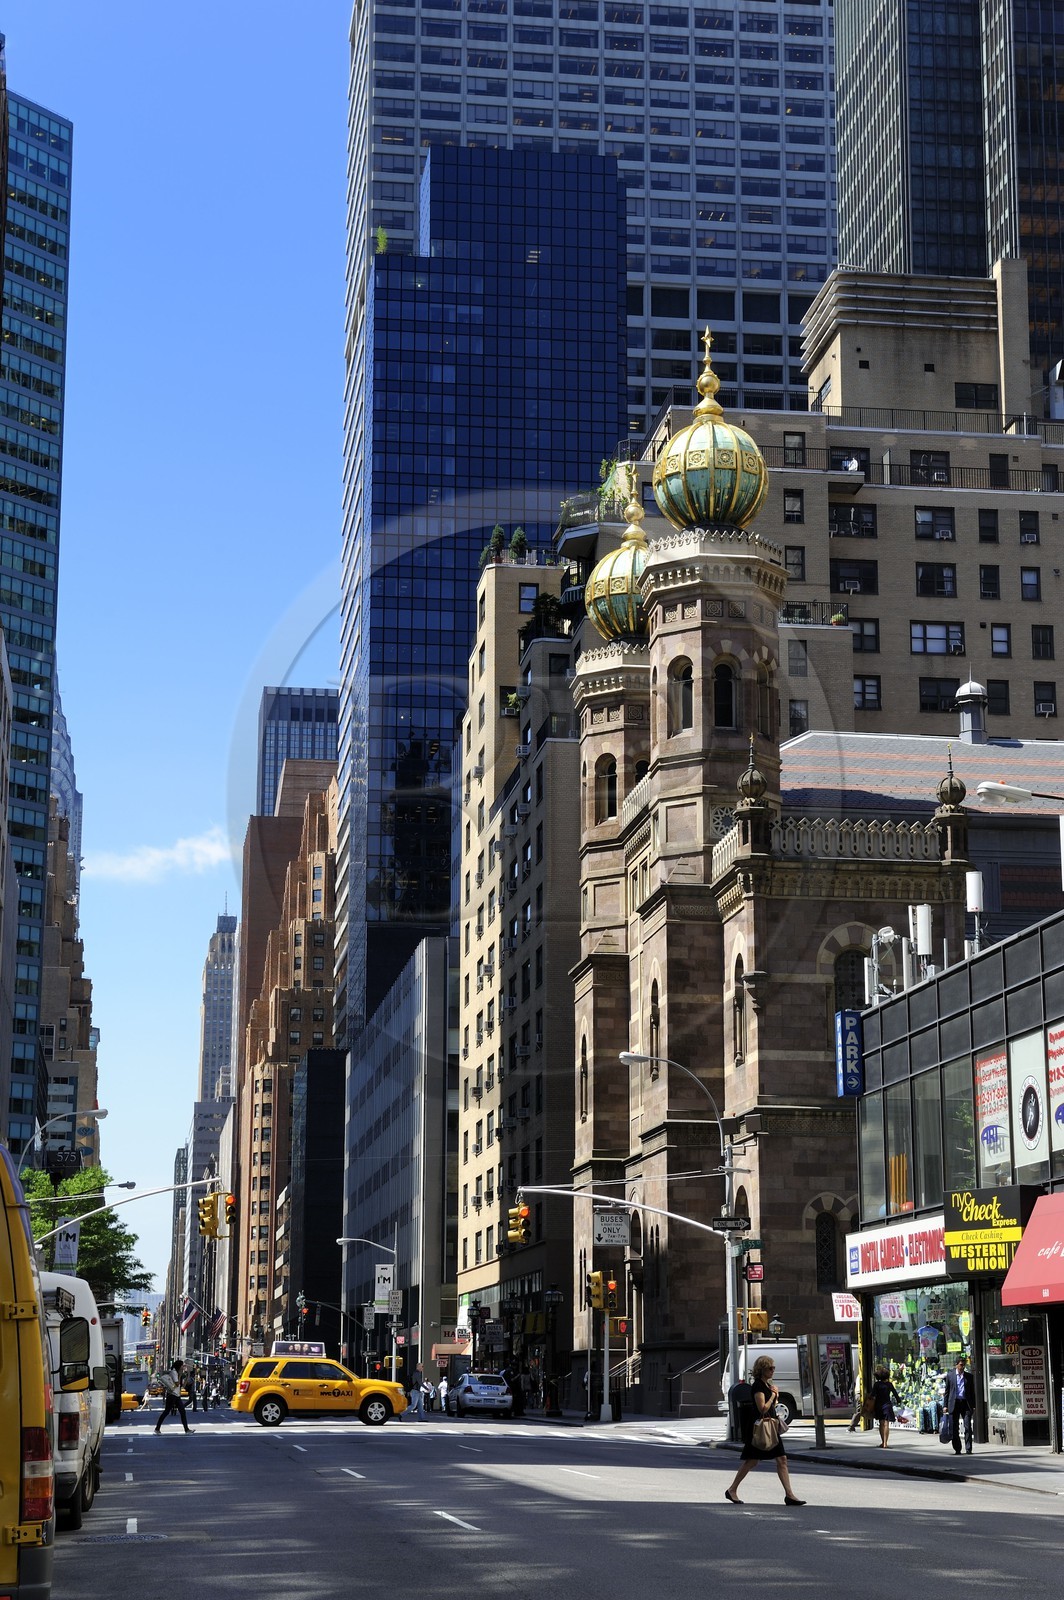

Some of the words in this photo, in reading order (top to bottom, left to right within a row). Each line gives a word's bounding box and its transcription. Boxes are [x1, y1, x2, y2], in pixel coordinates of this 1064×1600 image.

[845, 1016, 859, 1073] PARK
[57, 1152, 76, 1161] 575
[952, 1192, 971, 1212] nyc
[992, 1218, 1017, 1228] Express
[962, 1232, 979, 1241] Check
[980, 1230, 1003, 1240] Cashing
[880, 1235, 905, 1271] CAMERAS
[950, 1243, 1006, 1258] WESTERN
[1038, 1240, 1062, 1259] café
[967, 1256, 1006, 1271] UNION
